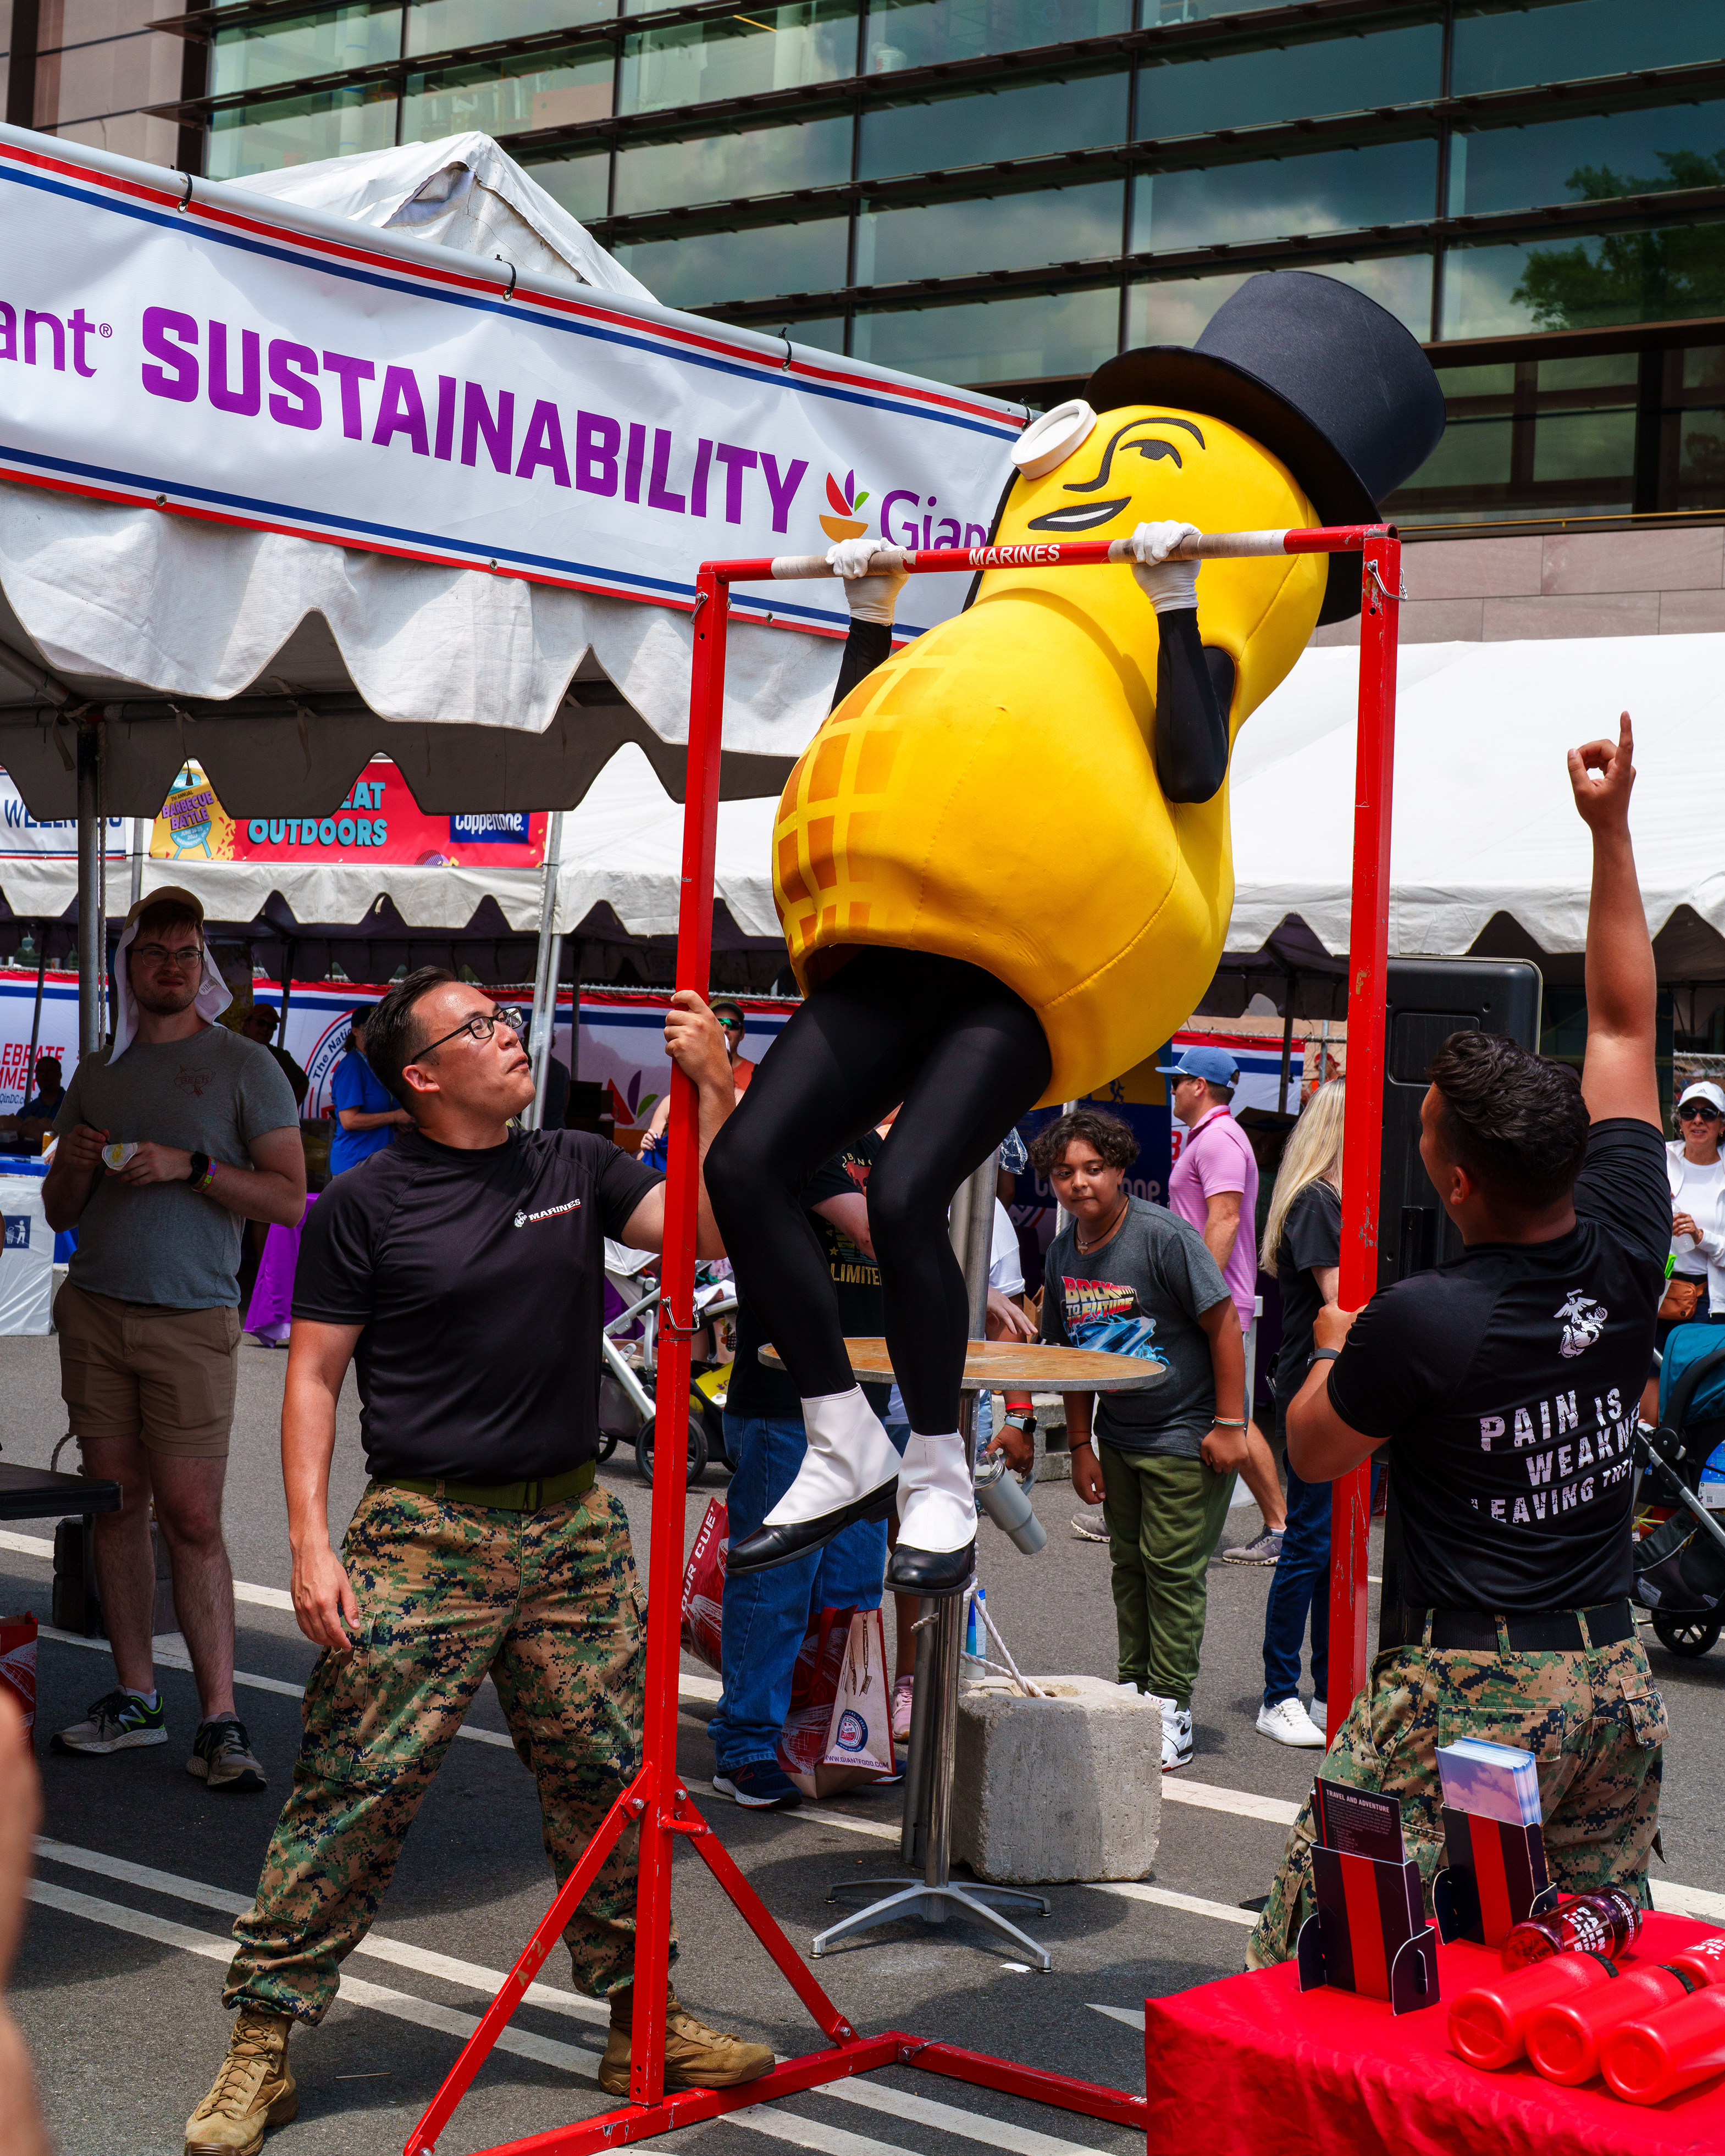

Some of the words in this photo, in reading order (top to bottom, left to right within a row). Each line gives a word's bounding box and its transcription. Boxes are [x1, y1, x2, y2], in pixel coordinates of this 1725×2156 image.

[142, 306, 809, 534] SUSTAINABILITY
[881, 490, 993, 550] Gian
[969, 544, 1060, 566] MARINES
[162, 791, 214, 819] BARBECUE
[178, 790, 193, 799] ANNUAL
[170, 807, 210, 830] BATTLE
[248, 818, 388, 847] OUTDOORS
[312, 1054, 329, 1079] The
[528, 1199, 581, 1221] MARINES
[831, 1263, 882, 1285] LIMITE
[1061, 1276, 1134, 1304] BACK
[1066, 1304, 1081, 1316] TO
[1067, 1314, 1081, 1327] THE
[1081, 1297, 1134, 1324] FUTURE
[1480, 1390, 1579, 1451] PAIN
[1594, 1388, 1622, 1426] IS
[1471, 1477, 1594, 1523] EAVING
[1326, 1789, 1346, 1800] TRAVEL
[1346, 1796, 1358, 1804] AND
[1358, 1799, 1390, 1813] ADVENTURE
[1571, 1912, 1584, 1921] IS
[1577, 1906, 1606, 1951] PAIN
